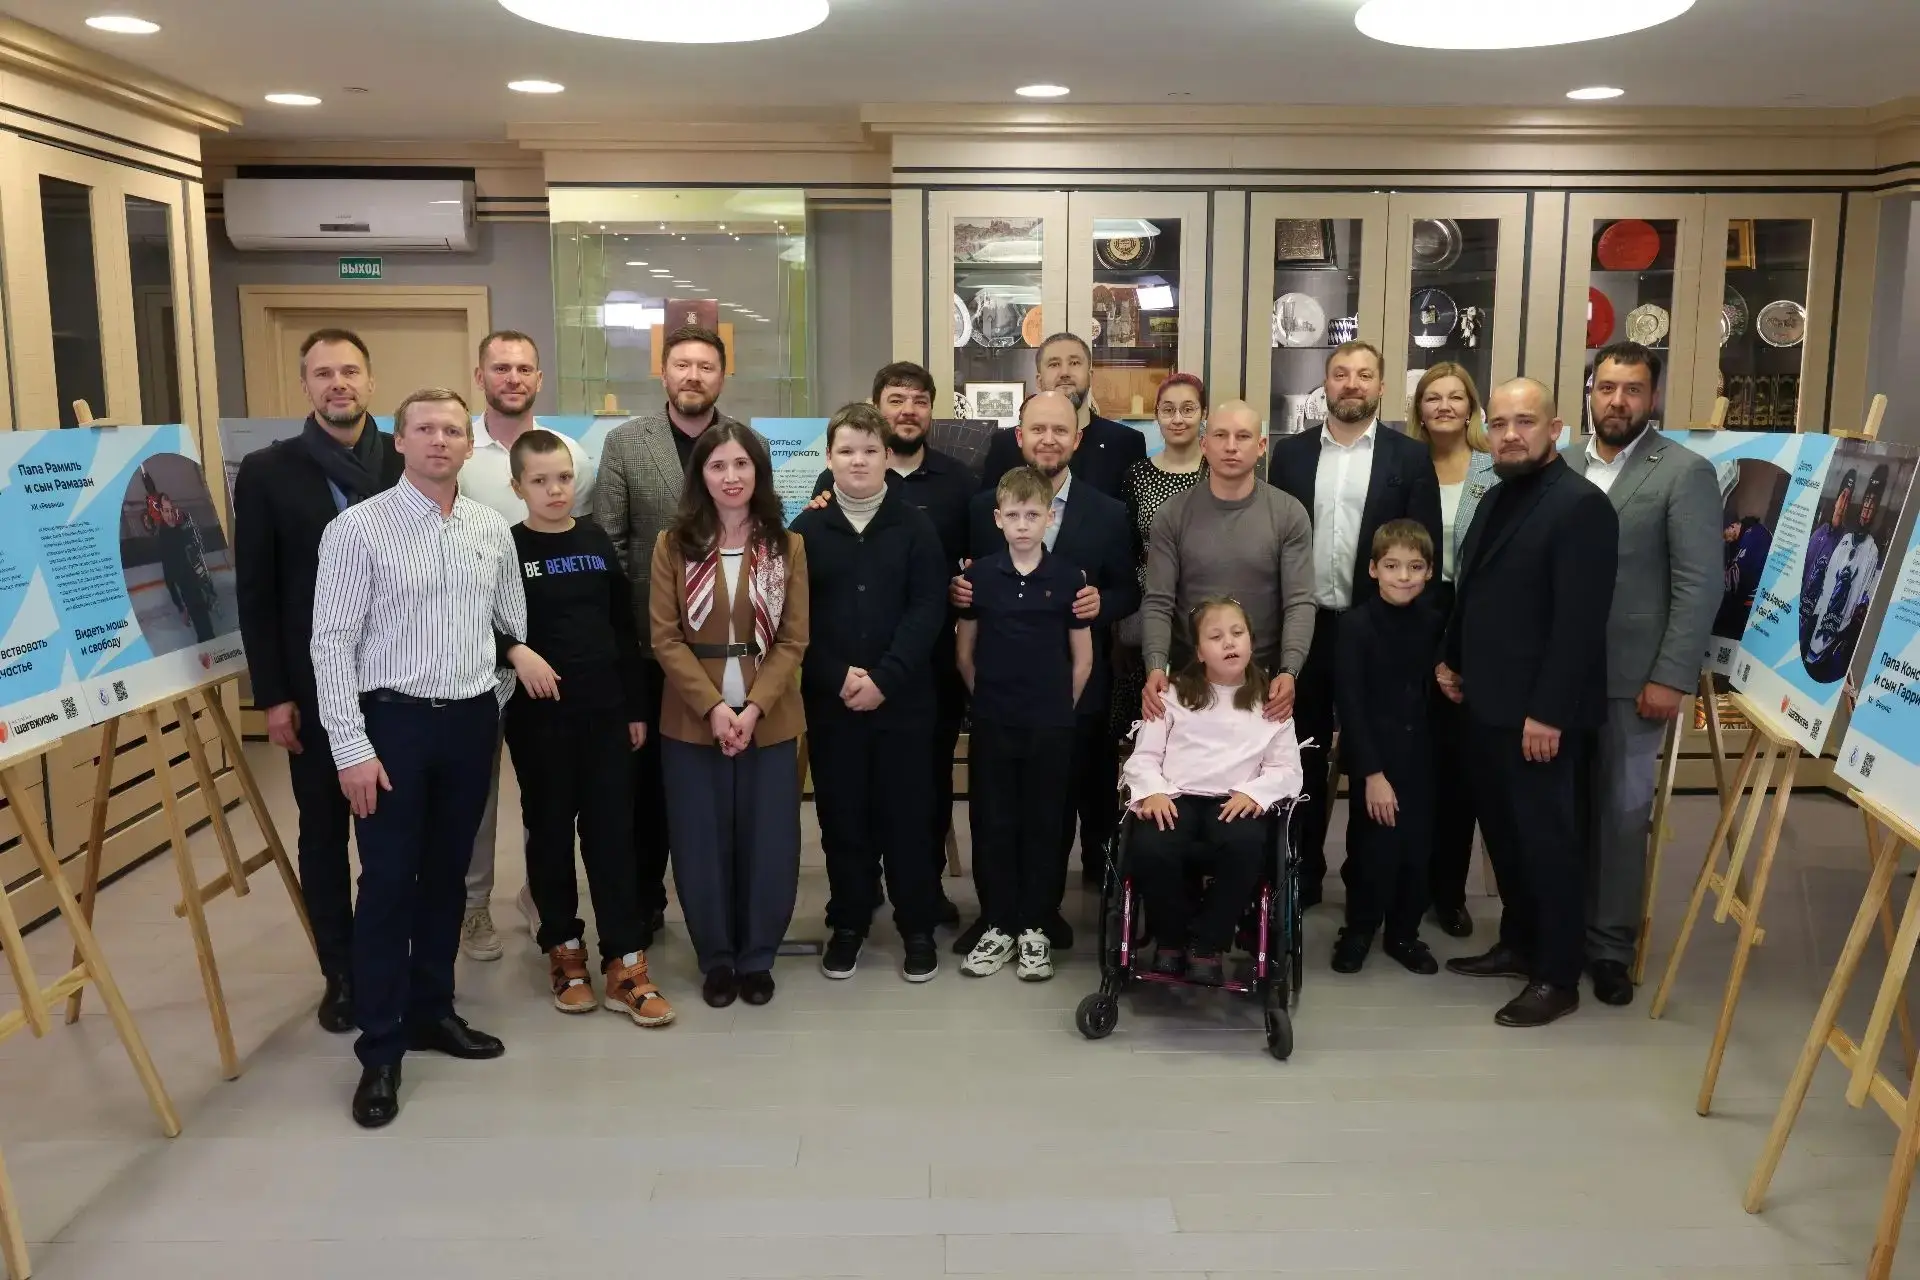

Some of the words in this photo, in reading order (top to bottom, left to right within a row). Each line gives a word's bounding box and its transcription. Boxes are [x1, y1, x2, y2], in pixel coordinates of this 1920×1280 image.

[341, 263, 381, 276] ВЫХОД
[771, 450, 820, 458] отпускать
[18, 464, 44, 476] Папа
[44, 461, 82, 474] Рамиль
[24, 484, 33, 494] и
[33, 482, 54, 493] сын
[53, 477, 95, 491] Рамазан
[524, 561, 542, 578] BE
[545, 555, 607, 575] BENETTON
[75, 625, 106, 641] Видеть
[105, 620, 129, 633] мощь
[81, 647, 88, 656] и
[88, 637, 121, 654] свободу
[0, 661, 33, 680] частье
[1880, 652, 1901, 672] Папа
[1873, 673, 1881, 686] и
[1880, 677, 1898, 694] сын
